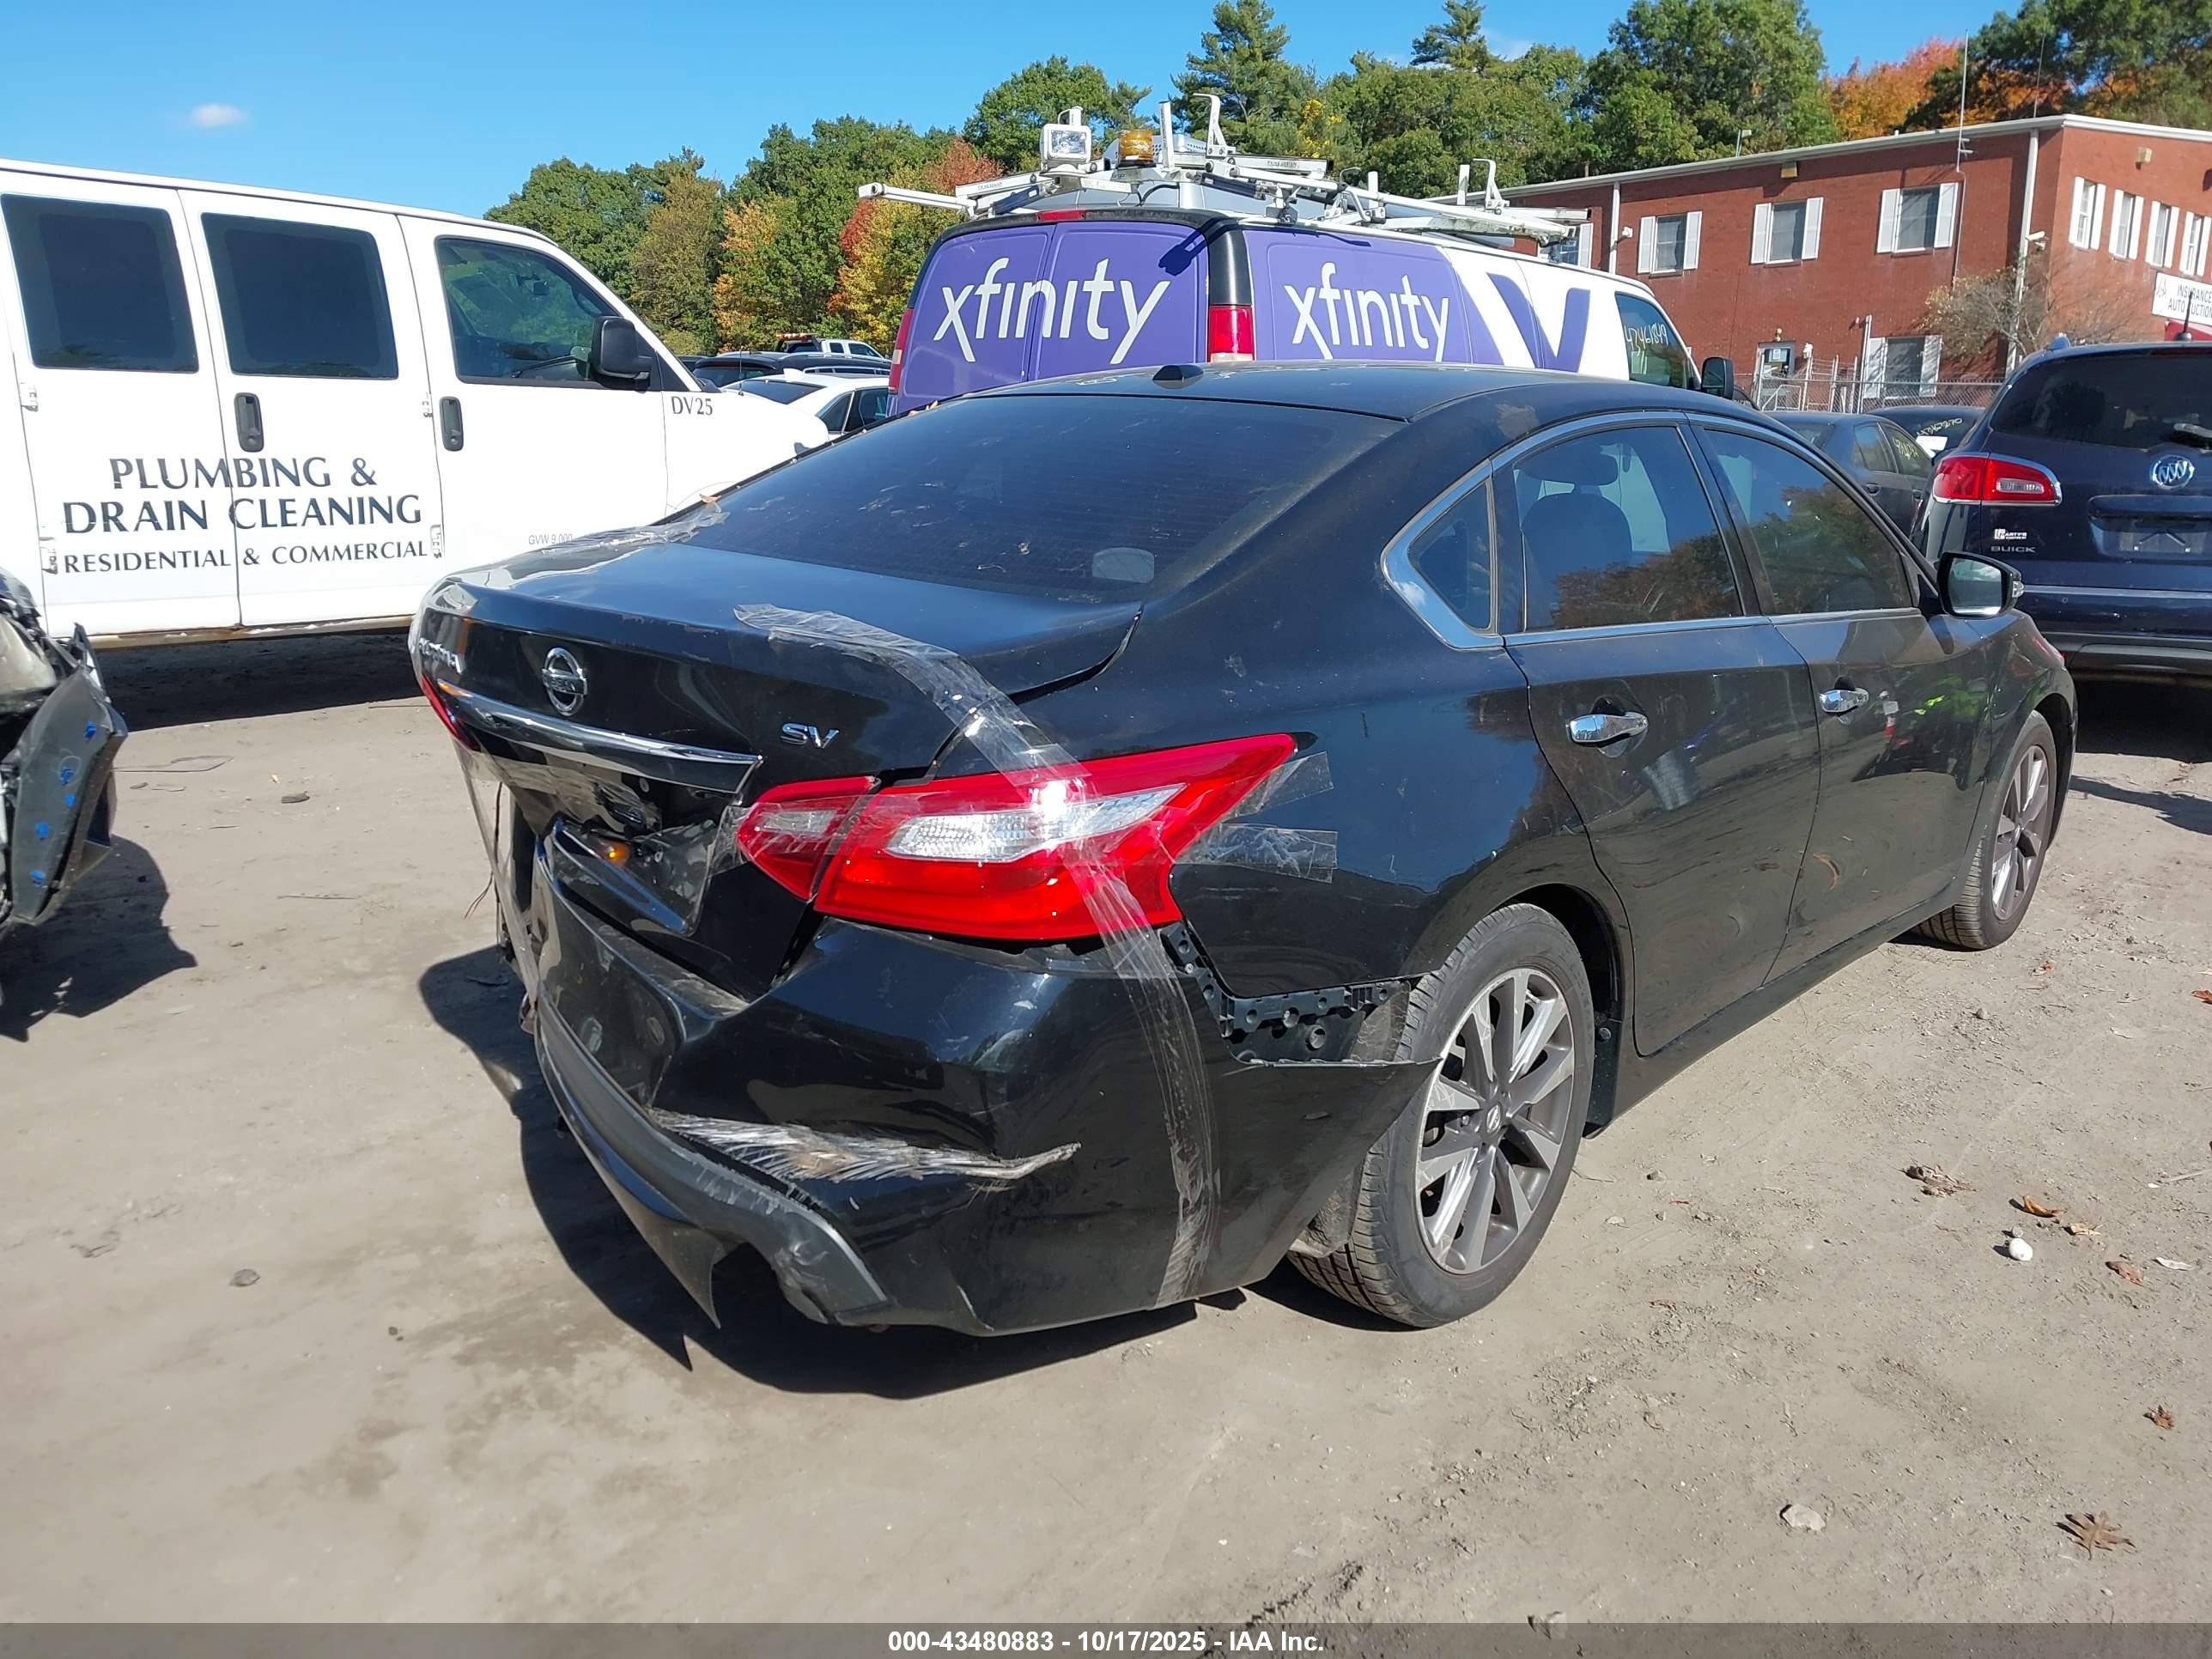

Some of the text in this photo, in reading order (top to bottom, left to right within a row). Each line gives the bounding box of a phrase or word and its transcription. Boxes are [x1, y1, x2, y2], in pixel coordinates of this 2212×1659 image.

[933, 258, 1170, 364] xfinity
[1284, 262, 1449, 362] xfinity
[2168, 298, 2185, 313] AUTO
[671, 396, 713, 416] DV25
[109, 457, 378, 489] PLUMBING &
[63, 495, 421, 533] DRAIN CLEANING
[528, 534, 549, 545] GVW
[64, 541, 428, 573] RESIDENTIAL & COMMERCIAL
[781, 723, 839, 749] SV
